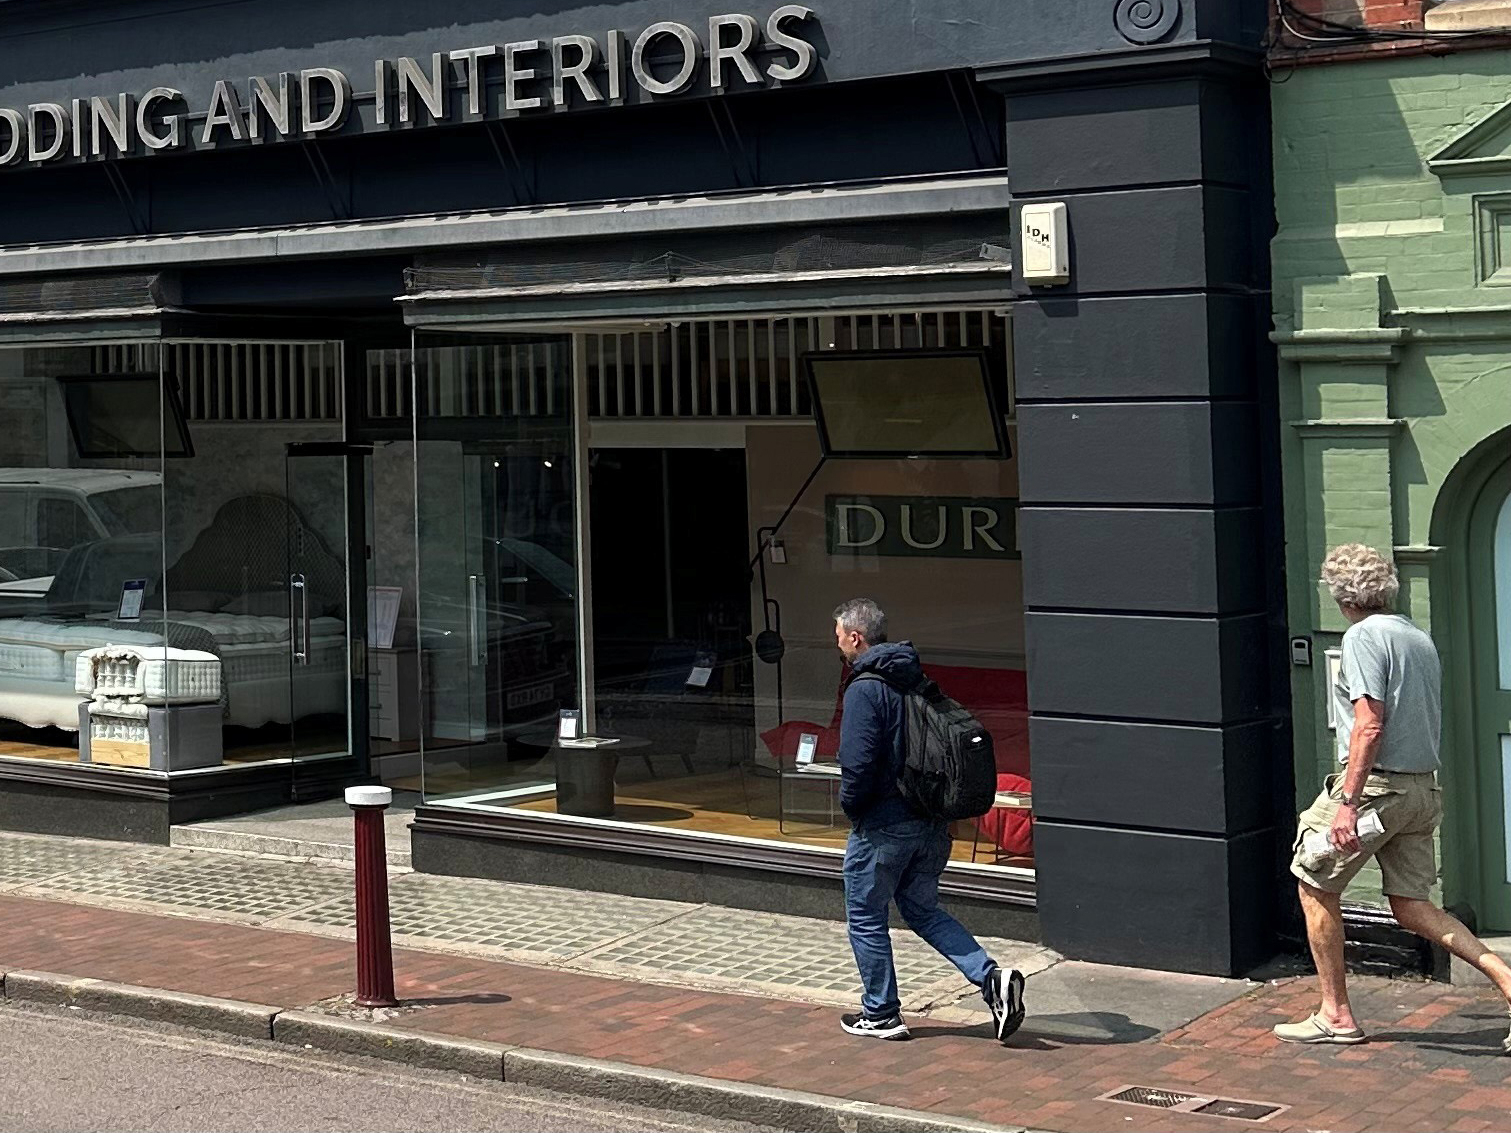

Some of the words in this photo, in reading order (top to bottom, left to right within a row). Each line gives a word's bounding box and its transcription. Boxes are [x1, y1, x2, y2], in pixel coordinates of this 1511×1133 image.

[202, 68, 351, 144] AND
[375, 5, 817, 125] INTERIORS
[835, 504, 1021, 552] DUR
